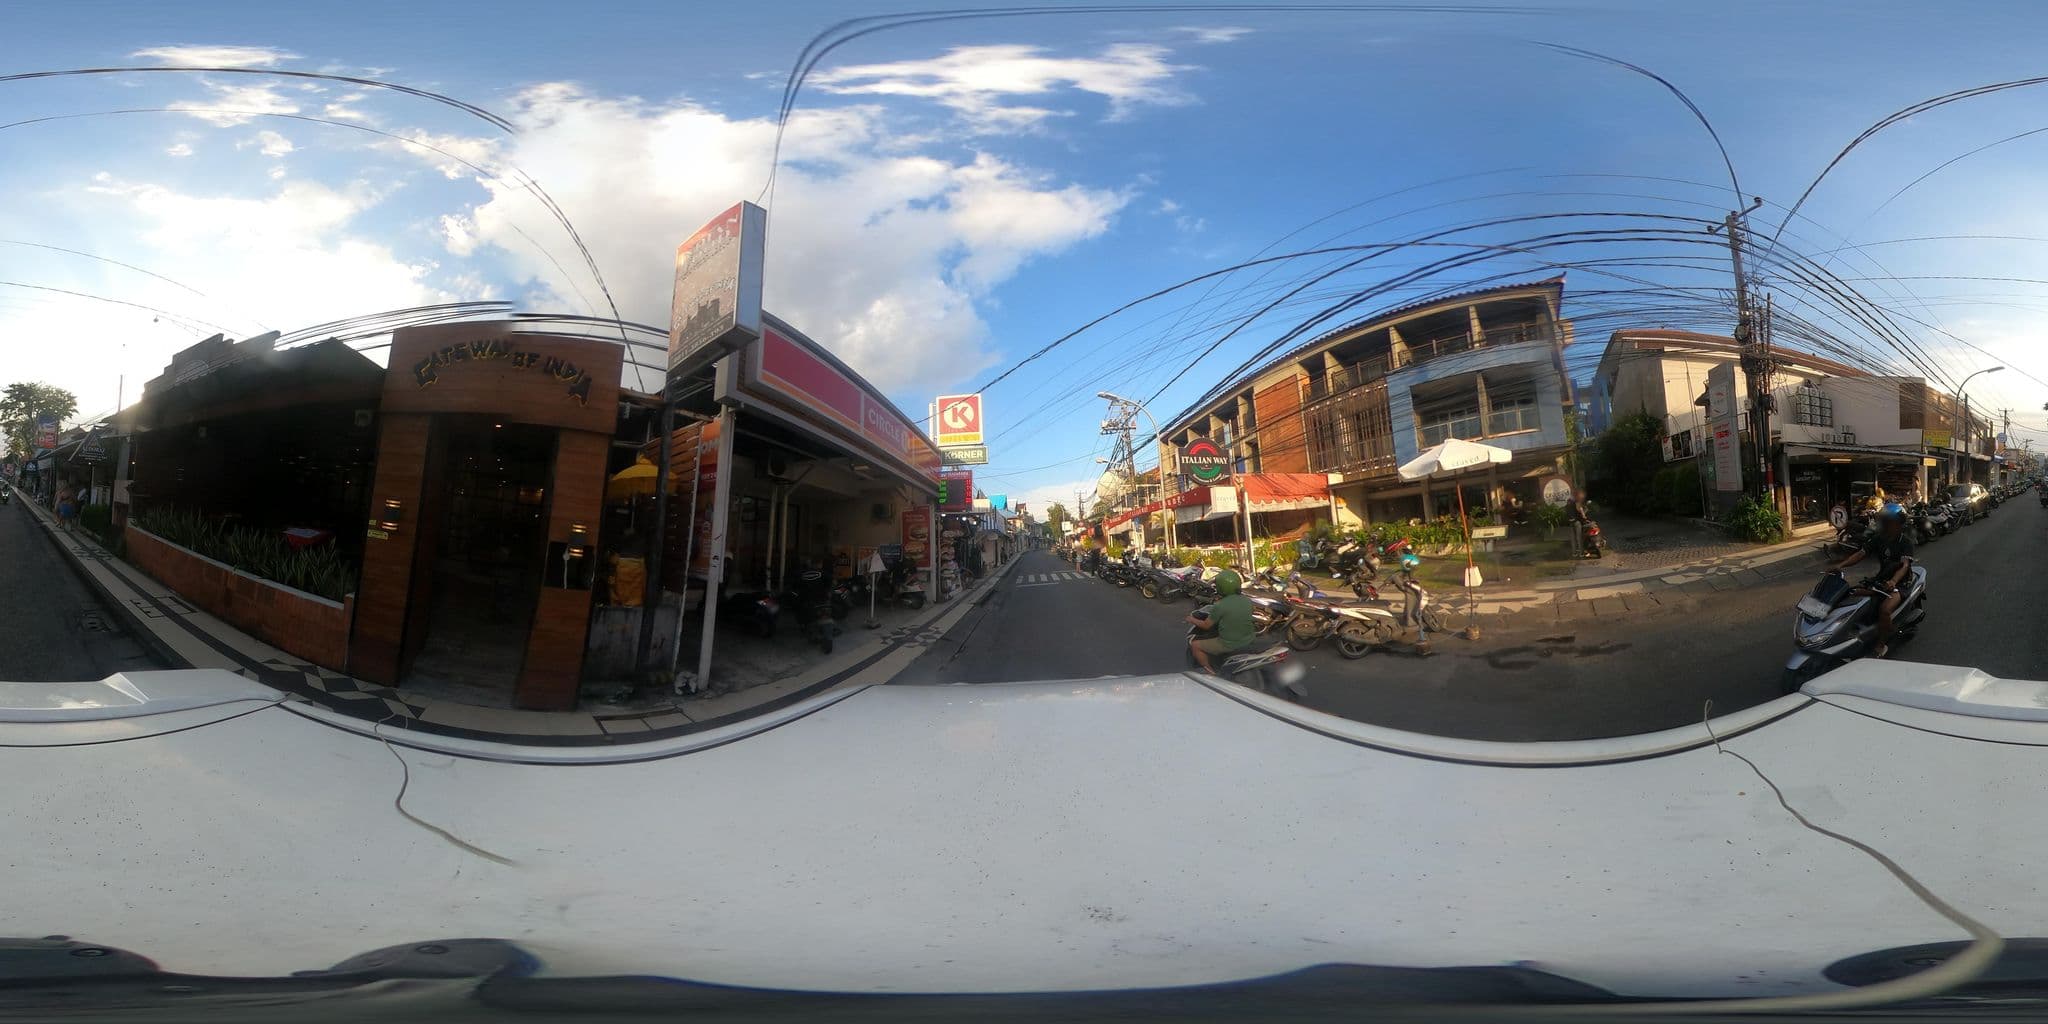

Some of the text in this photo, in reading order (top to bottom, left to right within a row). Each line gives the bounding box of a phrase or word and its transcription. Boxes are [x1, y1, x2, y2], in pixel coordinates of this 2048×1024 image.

[413, 339, 514, 391] GATEWAY
[868, 408, 900, 441] CIRCLE
[951, 406, 976, 429] K
[1181, 456, 1229, 465] ITALIAN WAY
